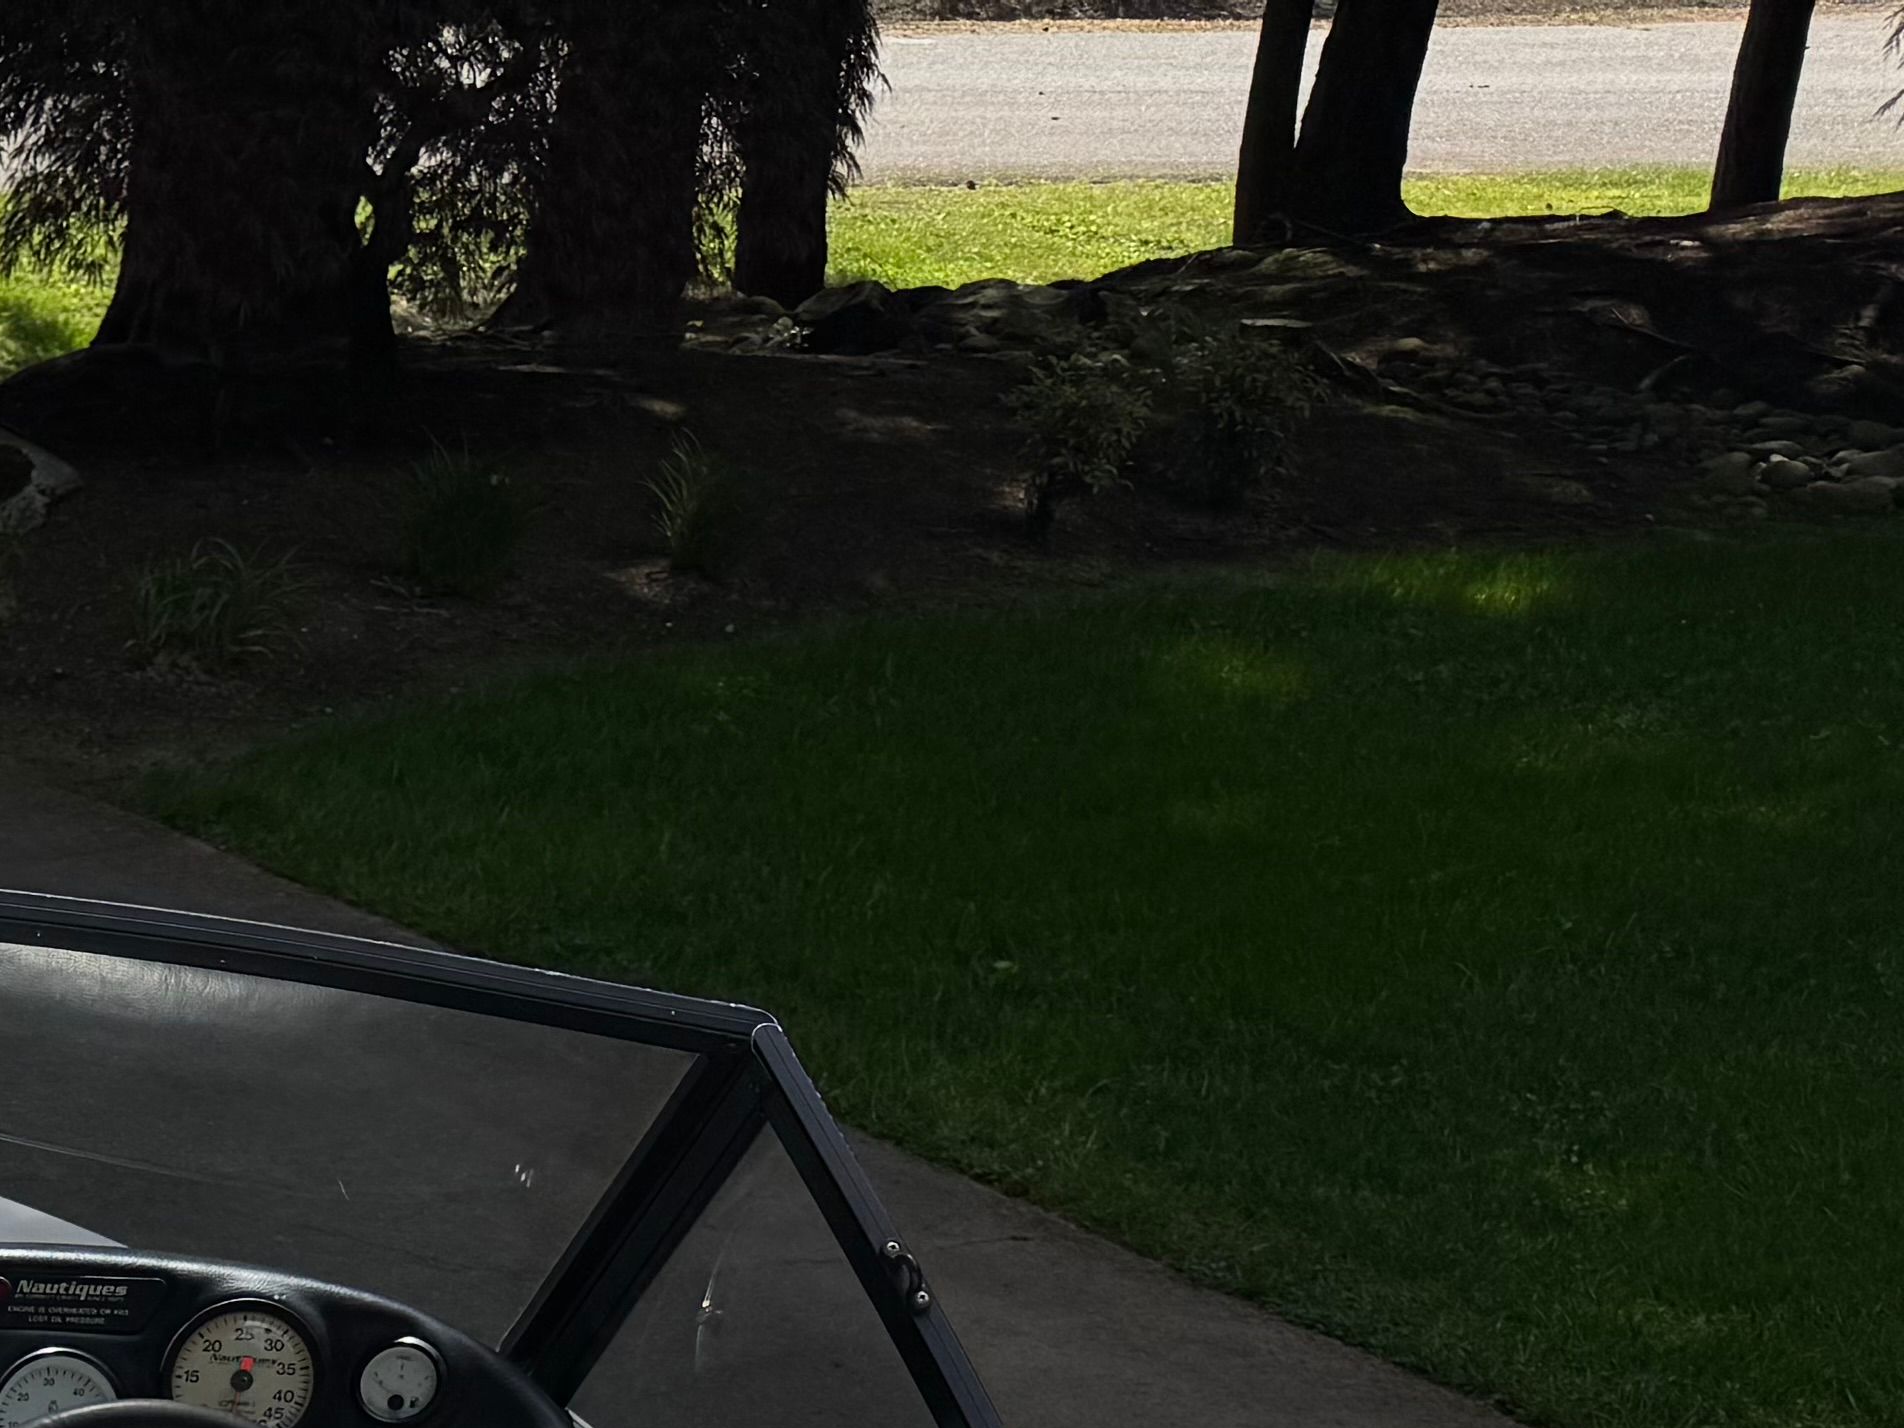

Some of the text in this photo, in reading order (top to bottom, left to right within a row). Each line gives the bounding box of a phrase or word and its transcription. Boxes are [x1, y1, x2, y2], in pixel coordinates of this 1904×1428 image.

[16, 1279, 128, 1300] Nautiques
[234, 1328, 255, 1341] 25
[202, 1339, 222, 1353] 20
[264, 1339, 285, 1352] 30
[276, 1362, 296, 1376] 35
[183, 1370, 200, 1383] 15
[17, 1392, 30, 1402] 20
[73, 1388, 85, 1397] 40
[272, 1389, 295, 1403] 40
[263, 1407, 284, 1419] 45
